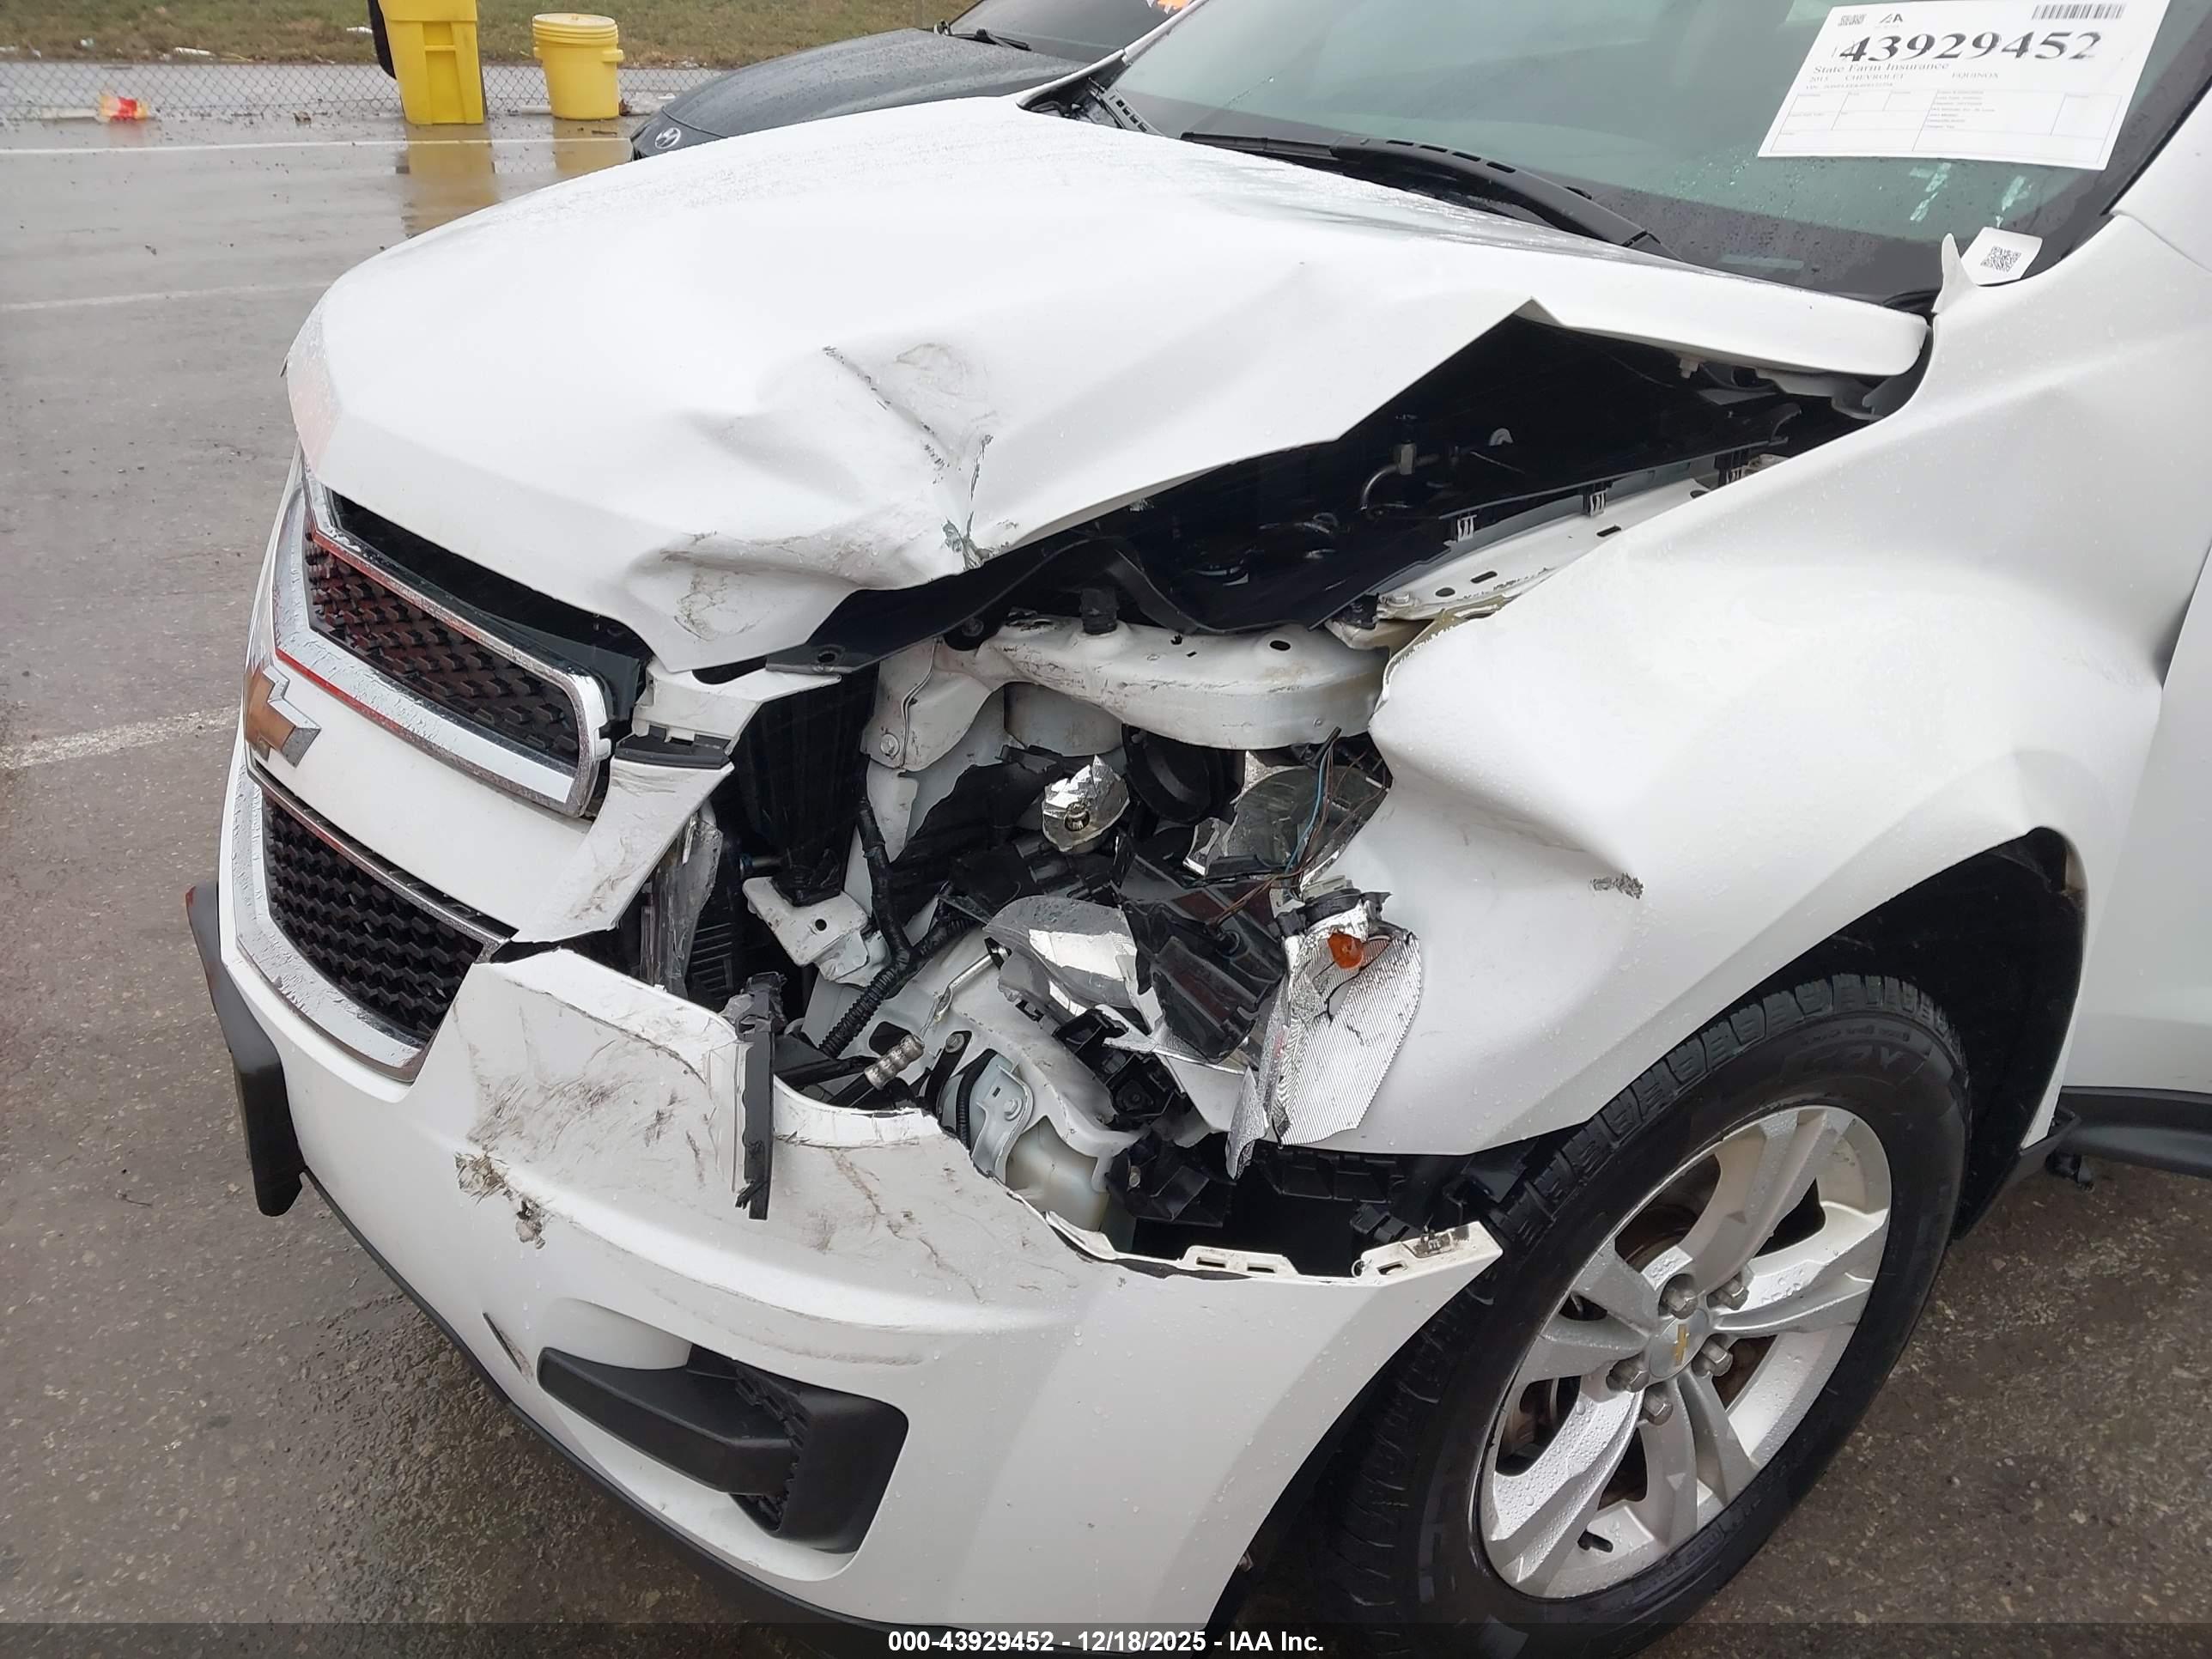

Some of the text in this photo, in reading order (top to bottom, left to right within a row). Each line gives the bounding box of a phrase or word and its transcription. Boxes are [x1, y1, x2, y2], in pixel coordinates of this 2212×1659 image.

[1839, 31, 2102, 63] 43929452
[1813, 62, 1950, 75] State Farm Insurance
